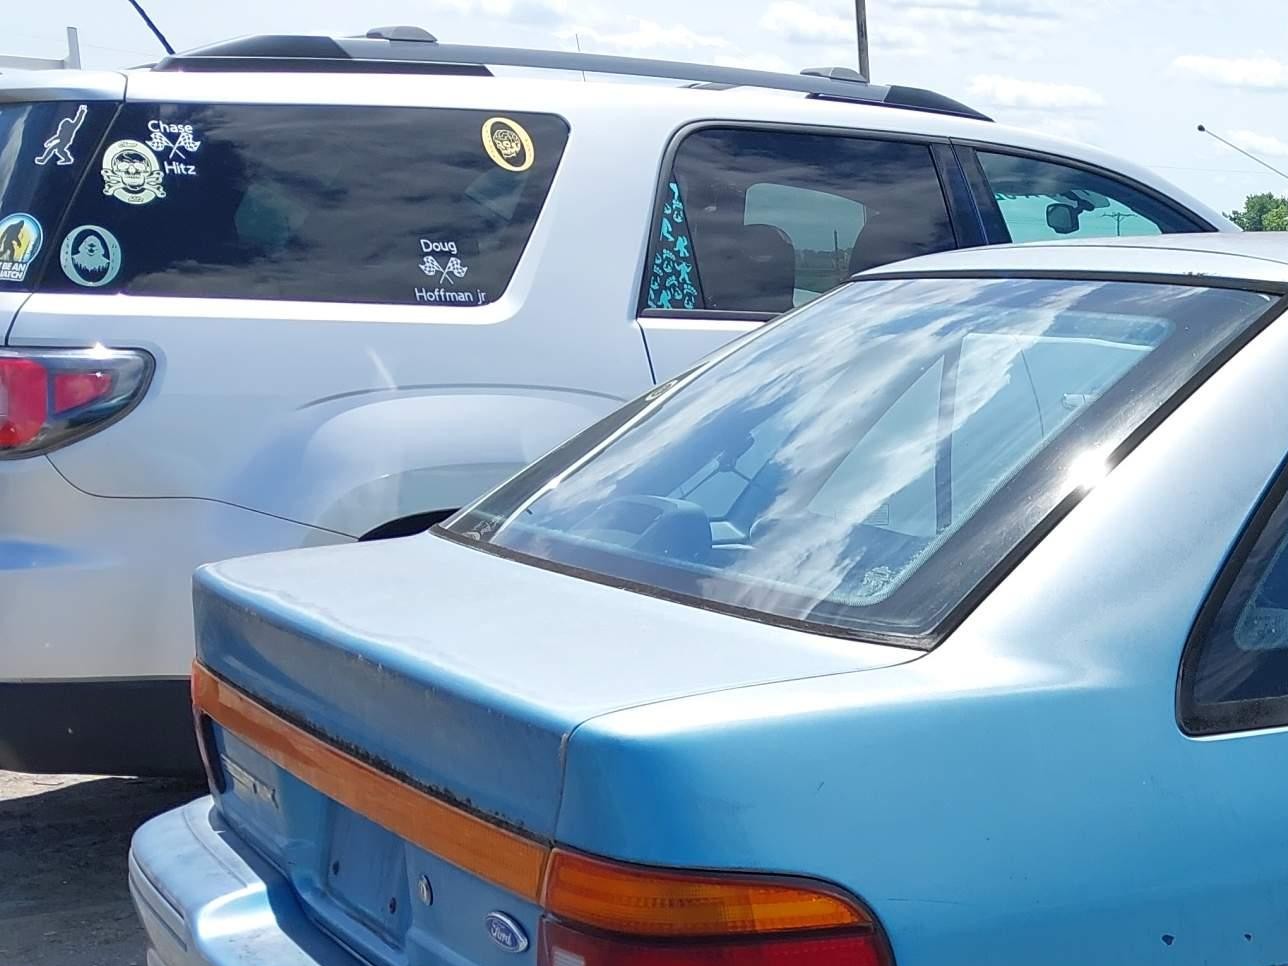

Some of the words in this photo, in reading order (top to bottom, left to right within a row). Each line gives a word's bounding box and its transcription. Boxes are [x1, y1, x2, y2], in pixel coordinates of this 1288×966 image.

[147, 120, 193, 133] Chase
[164, 161, 197, 175] Hitz
[420, 239, 457, 254] Doug
[11, 262, 27, 272] AN
[415, 287, 473, 301] Hoffman
[477, 289, 486, 304] jr
